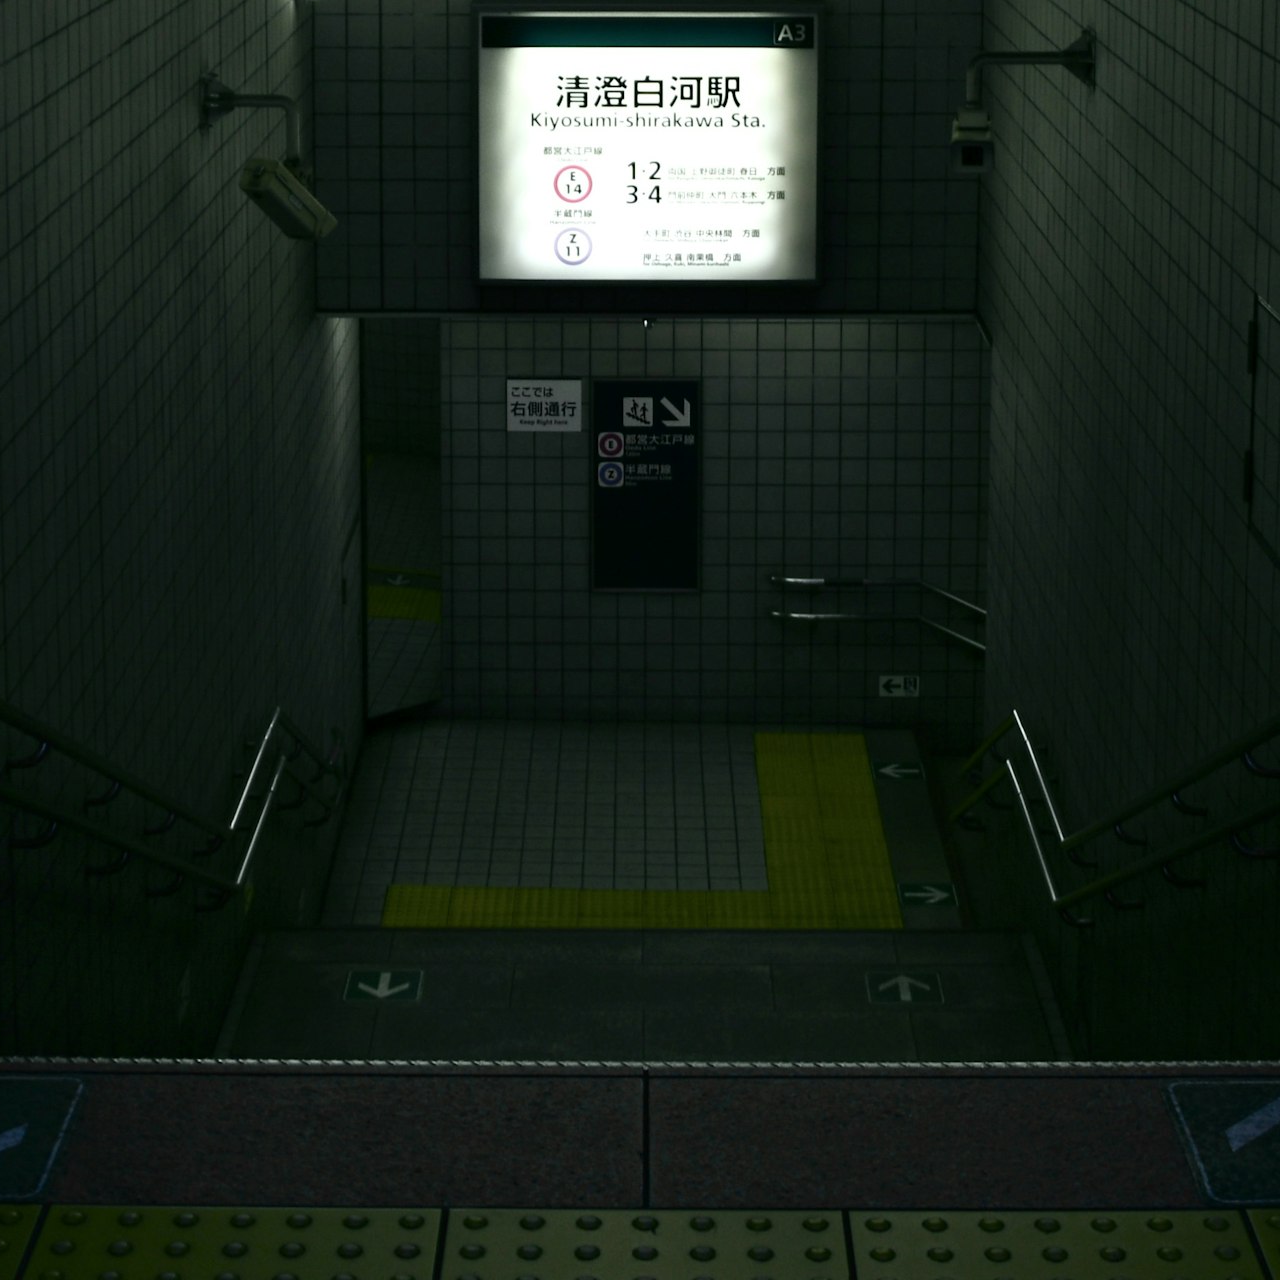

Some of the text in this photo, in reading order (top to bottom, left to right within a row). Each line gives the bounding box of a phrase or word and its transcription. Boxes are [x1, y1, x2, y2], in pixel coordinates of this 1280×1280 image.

[777, 24, 806, 41] A3
[556, 75, 741, 108] 清澄白河駅
[530, 113, 767, 131] Kiyosumi-shirakawa Sta.
[569, 171, 577, 181] E
[767, 166, 786, 176] 方面
[565, 183, 583, 195] 14
[767, 190, 786, 200] 方面
[568, 233, 577, 244] Z
[742, 229, 760, 238] 方面
[565, 245, 581, 257] 11
[723, 252, 742, 262] 方面
[511, 386, 554, 398] ここでは
[510, 401, 577, 417] 右側通行
[608, 440, 615, 449] E
[625, 433, 696, 447] 都営大江戸線
[607, 470, 615, 479] Z
